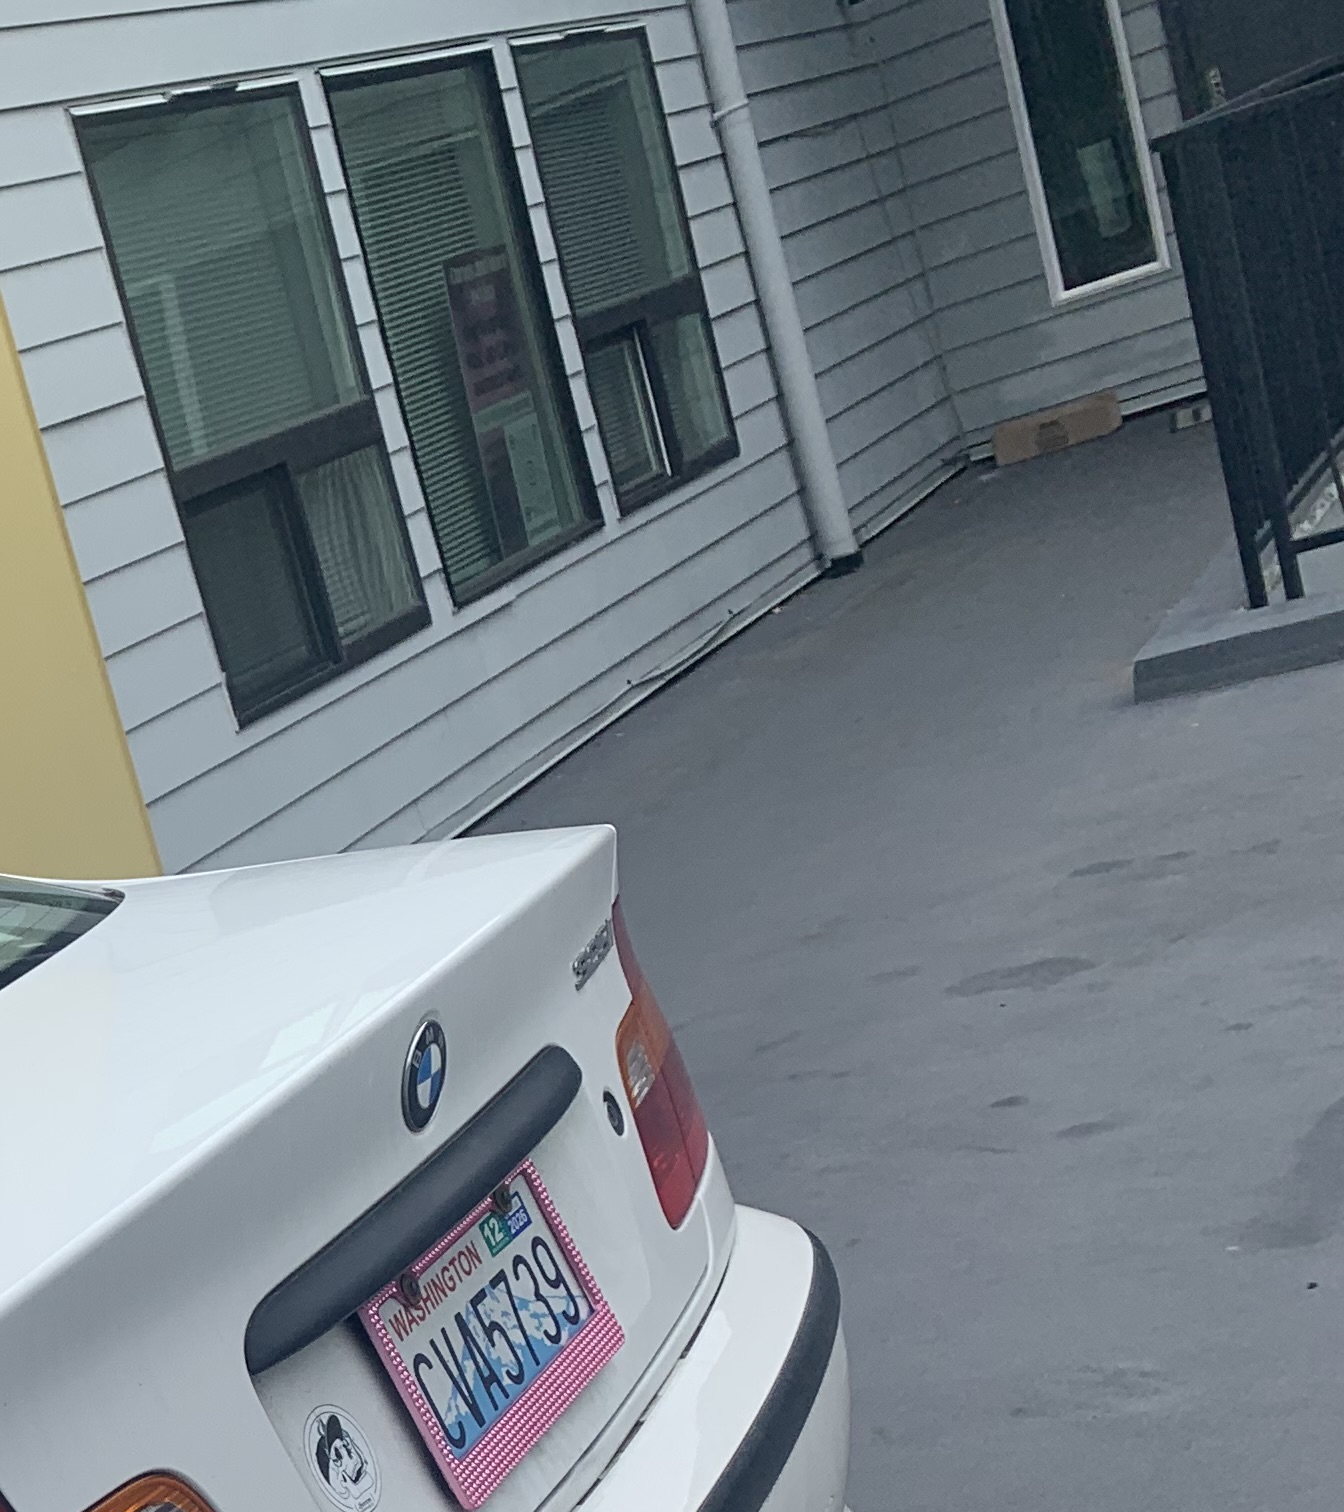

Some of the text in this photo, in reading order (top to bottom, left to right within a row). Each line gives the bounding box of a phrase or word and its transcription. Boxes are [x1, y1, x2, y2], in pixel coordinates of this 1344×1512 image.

[483, 1218, 504, 1244] 12
[388, 1240, 484, 1343] WASHINGTON
[412, 1235, 582, 1451] CVA5739
